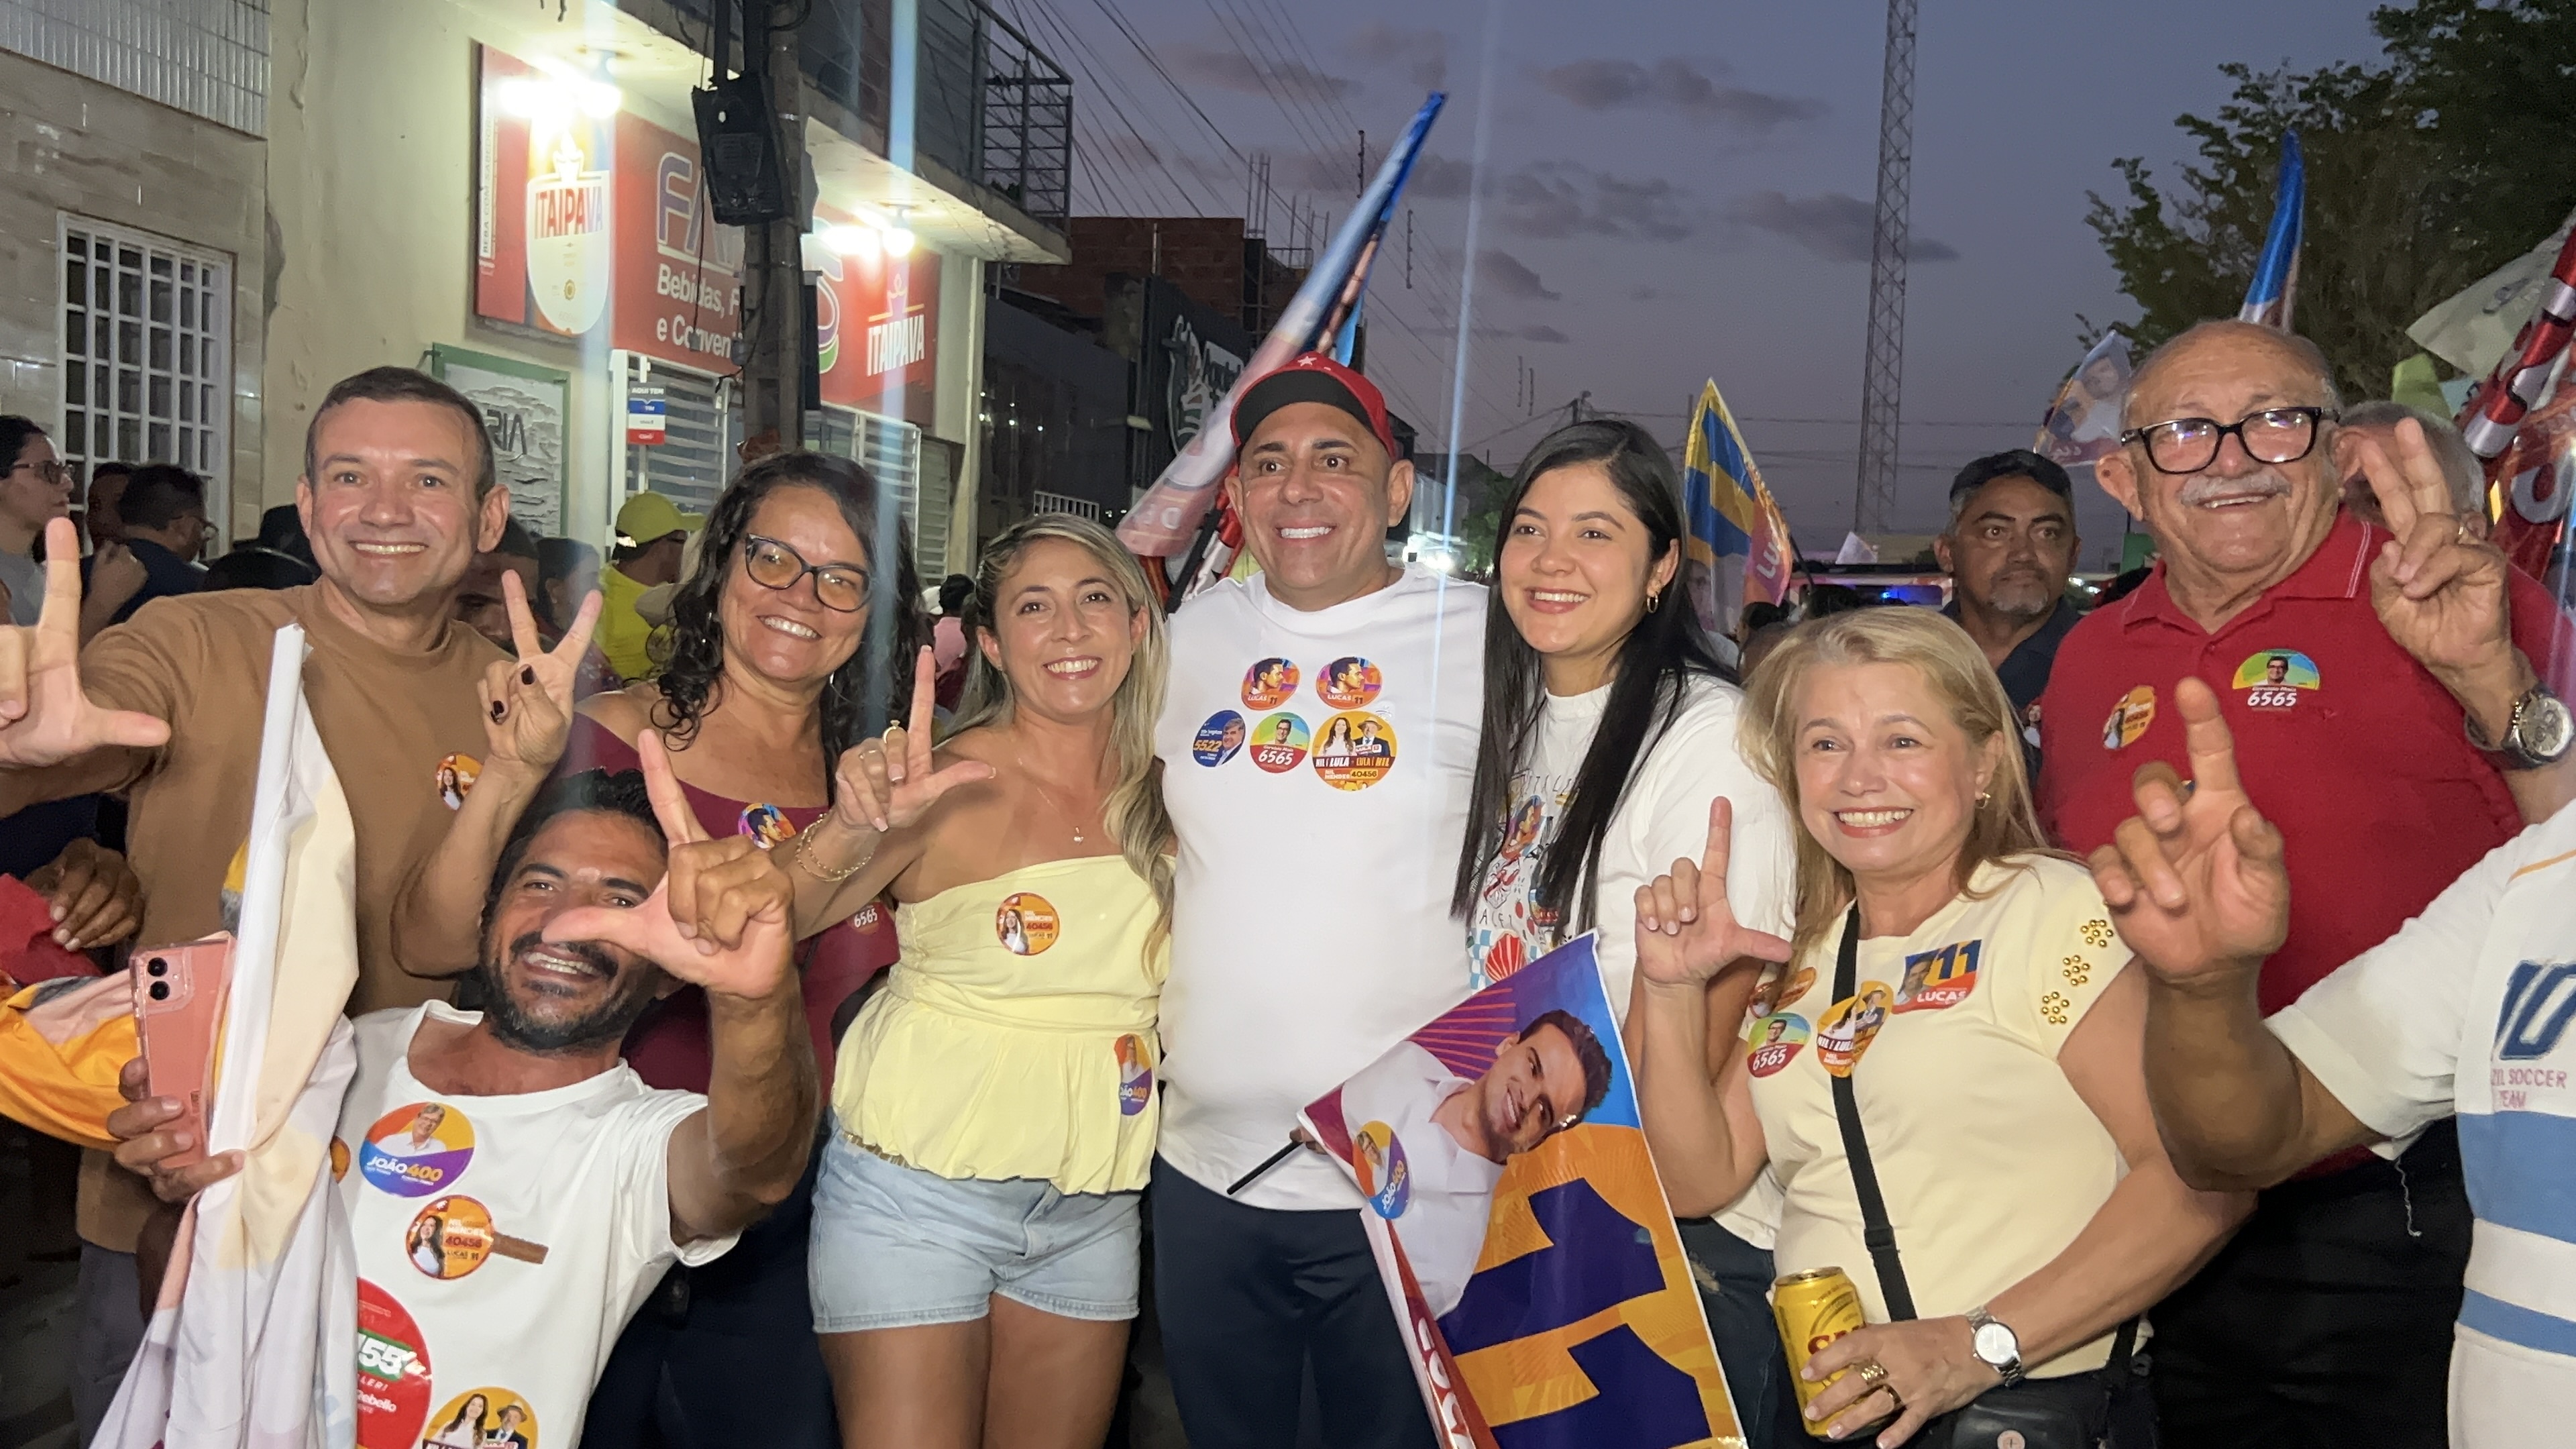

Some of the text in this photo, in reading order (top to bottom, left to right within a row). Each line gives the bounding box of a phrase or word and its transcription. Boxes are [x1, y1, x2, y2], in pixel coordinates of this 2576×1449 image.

[534, 186, 603, 239] ITAIPAVA
[657, 263, 725, 319] Bebidas,
[656, 317, 667, 342] e
[867, 313, 925, 377] ITAIPAVA
[1247, 694, 1278, 705] LUCAS 11
[1327, 694, 1363, 704] LUCAS 11
[2247, 692, 2297, 706] 6565
[1193, 739, 1223, 753] 5522
[1258, 749, 1295, 765] 6565
[1329, 757, 1350, 767] LULA
[854, 908, 877, 928] 6565
[1936, 939, 1982, 980] 11
[1917, 990, 1967, 1005] LUCAS
[1752, 1048, 1787, 1071] 6565
[2508, 1067, 2568, 1089] SOCCER
